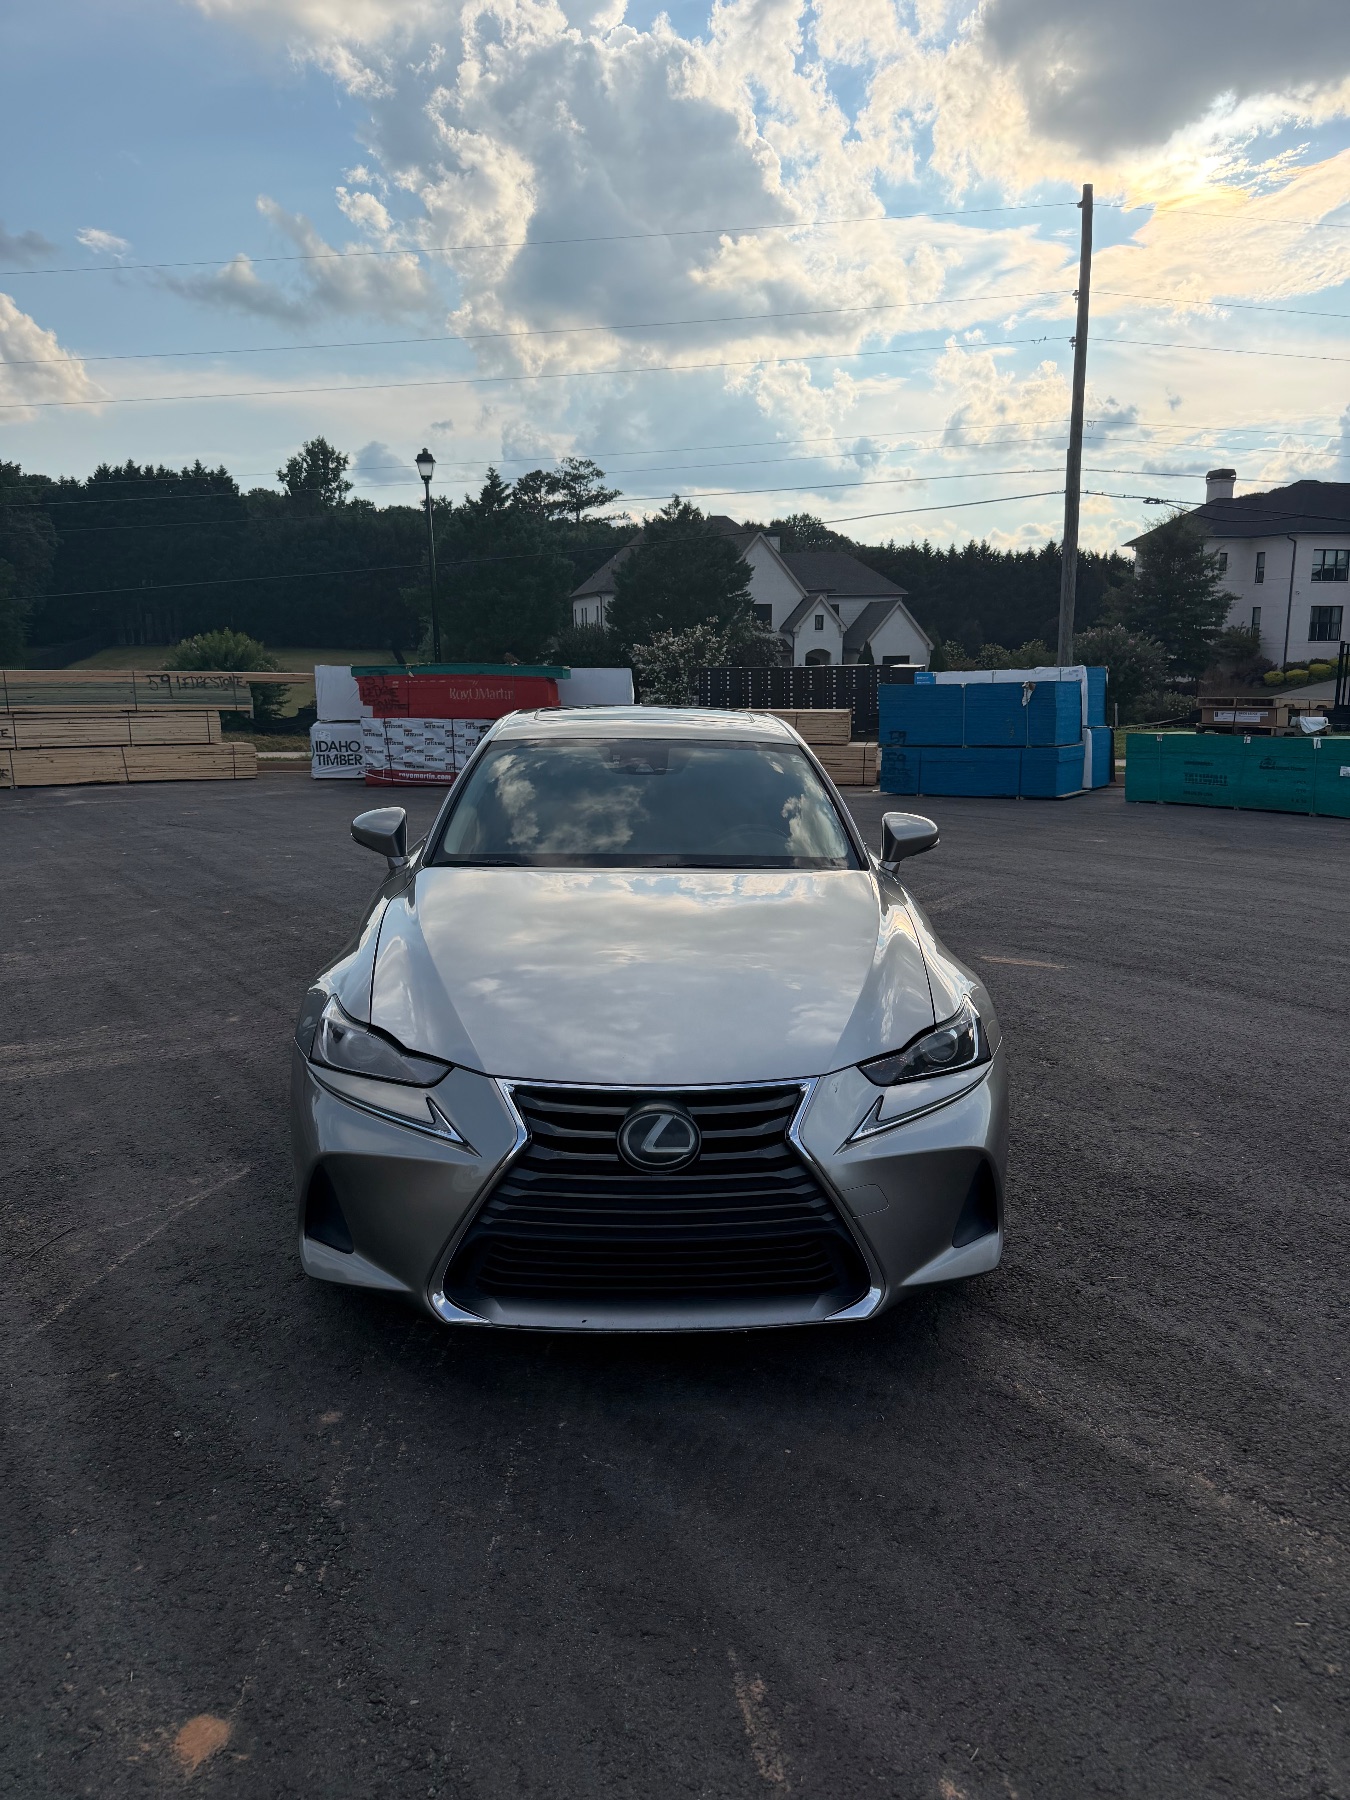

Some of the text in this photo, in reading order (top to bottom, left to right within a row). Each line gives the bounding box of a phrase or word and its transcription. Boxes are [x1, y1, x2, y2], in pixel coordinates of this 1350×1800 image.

[145, 674, 172, 698] 59
[315, 740, 361, 753] IDAHO
[315, 753, 363, 766] TIMBER
